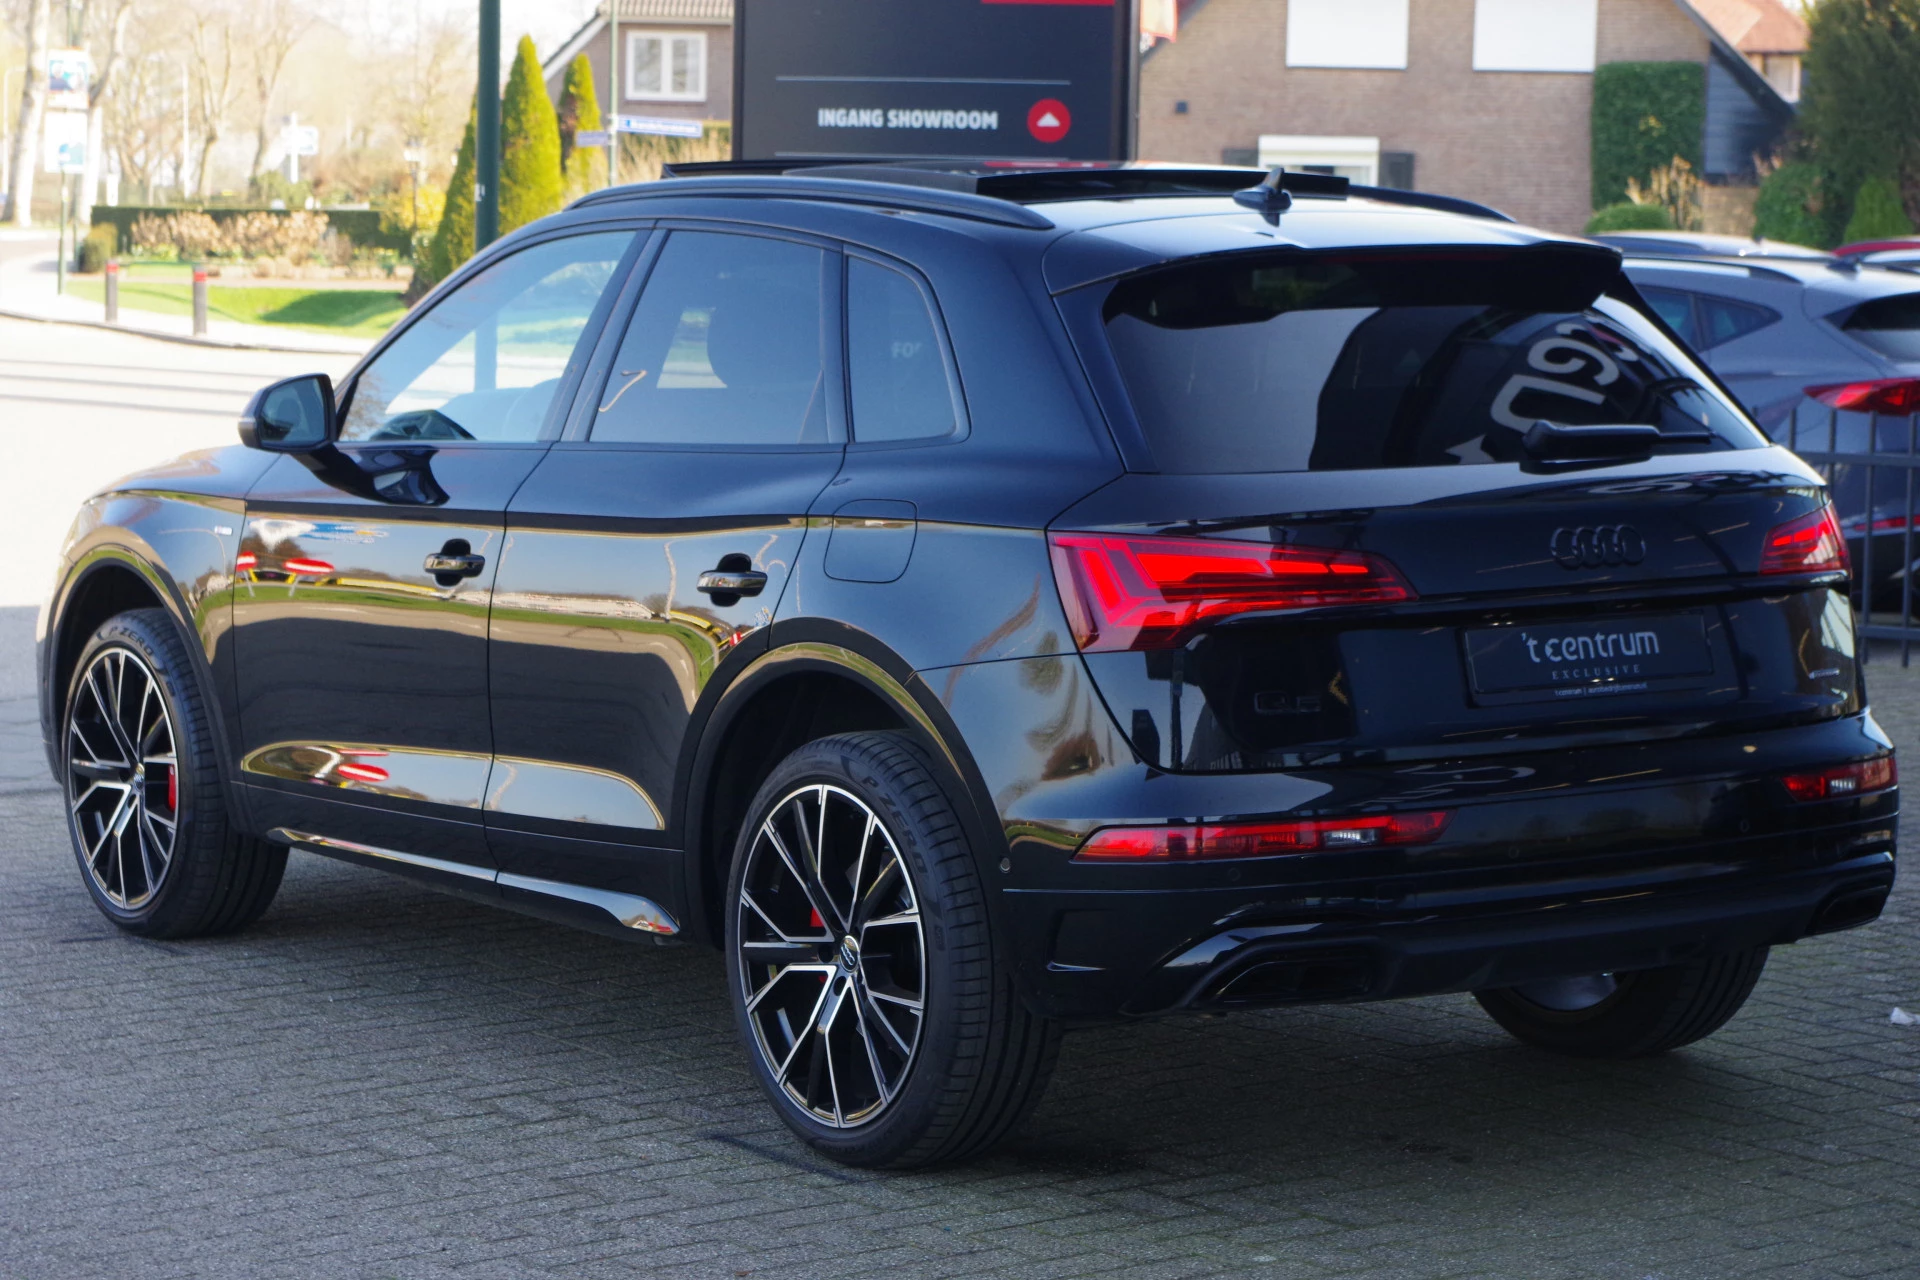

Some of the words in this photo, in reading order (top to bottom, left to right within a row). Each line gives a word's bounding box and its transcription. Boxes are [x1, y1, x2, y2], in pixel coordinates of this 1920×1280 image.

[818, 107, 883, 128] INGANG
[887, 109, 998, 130] SHOWROOM
[1544, 631, 1660, 663] centrum
[1552, 664, 1641, 680] EXCLUSIVE
[878, 793, 928, 873] ZERO
